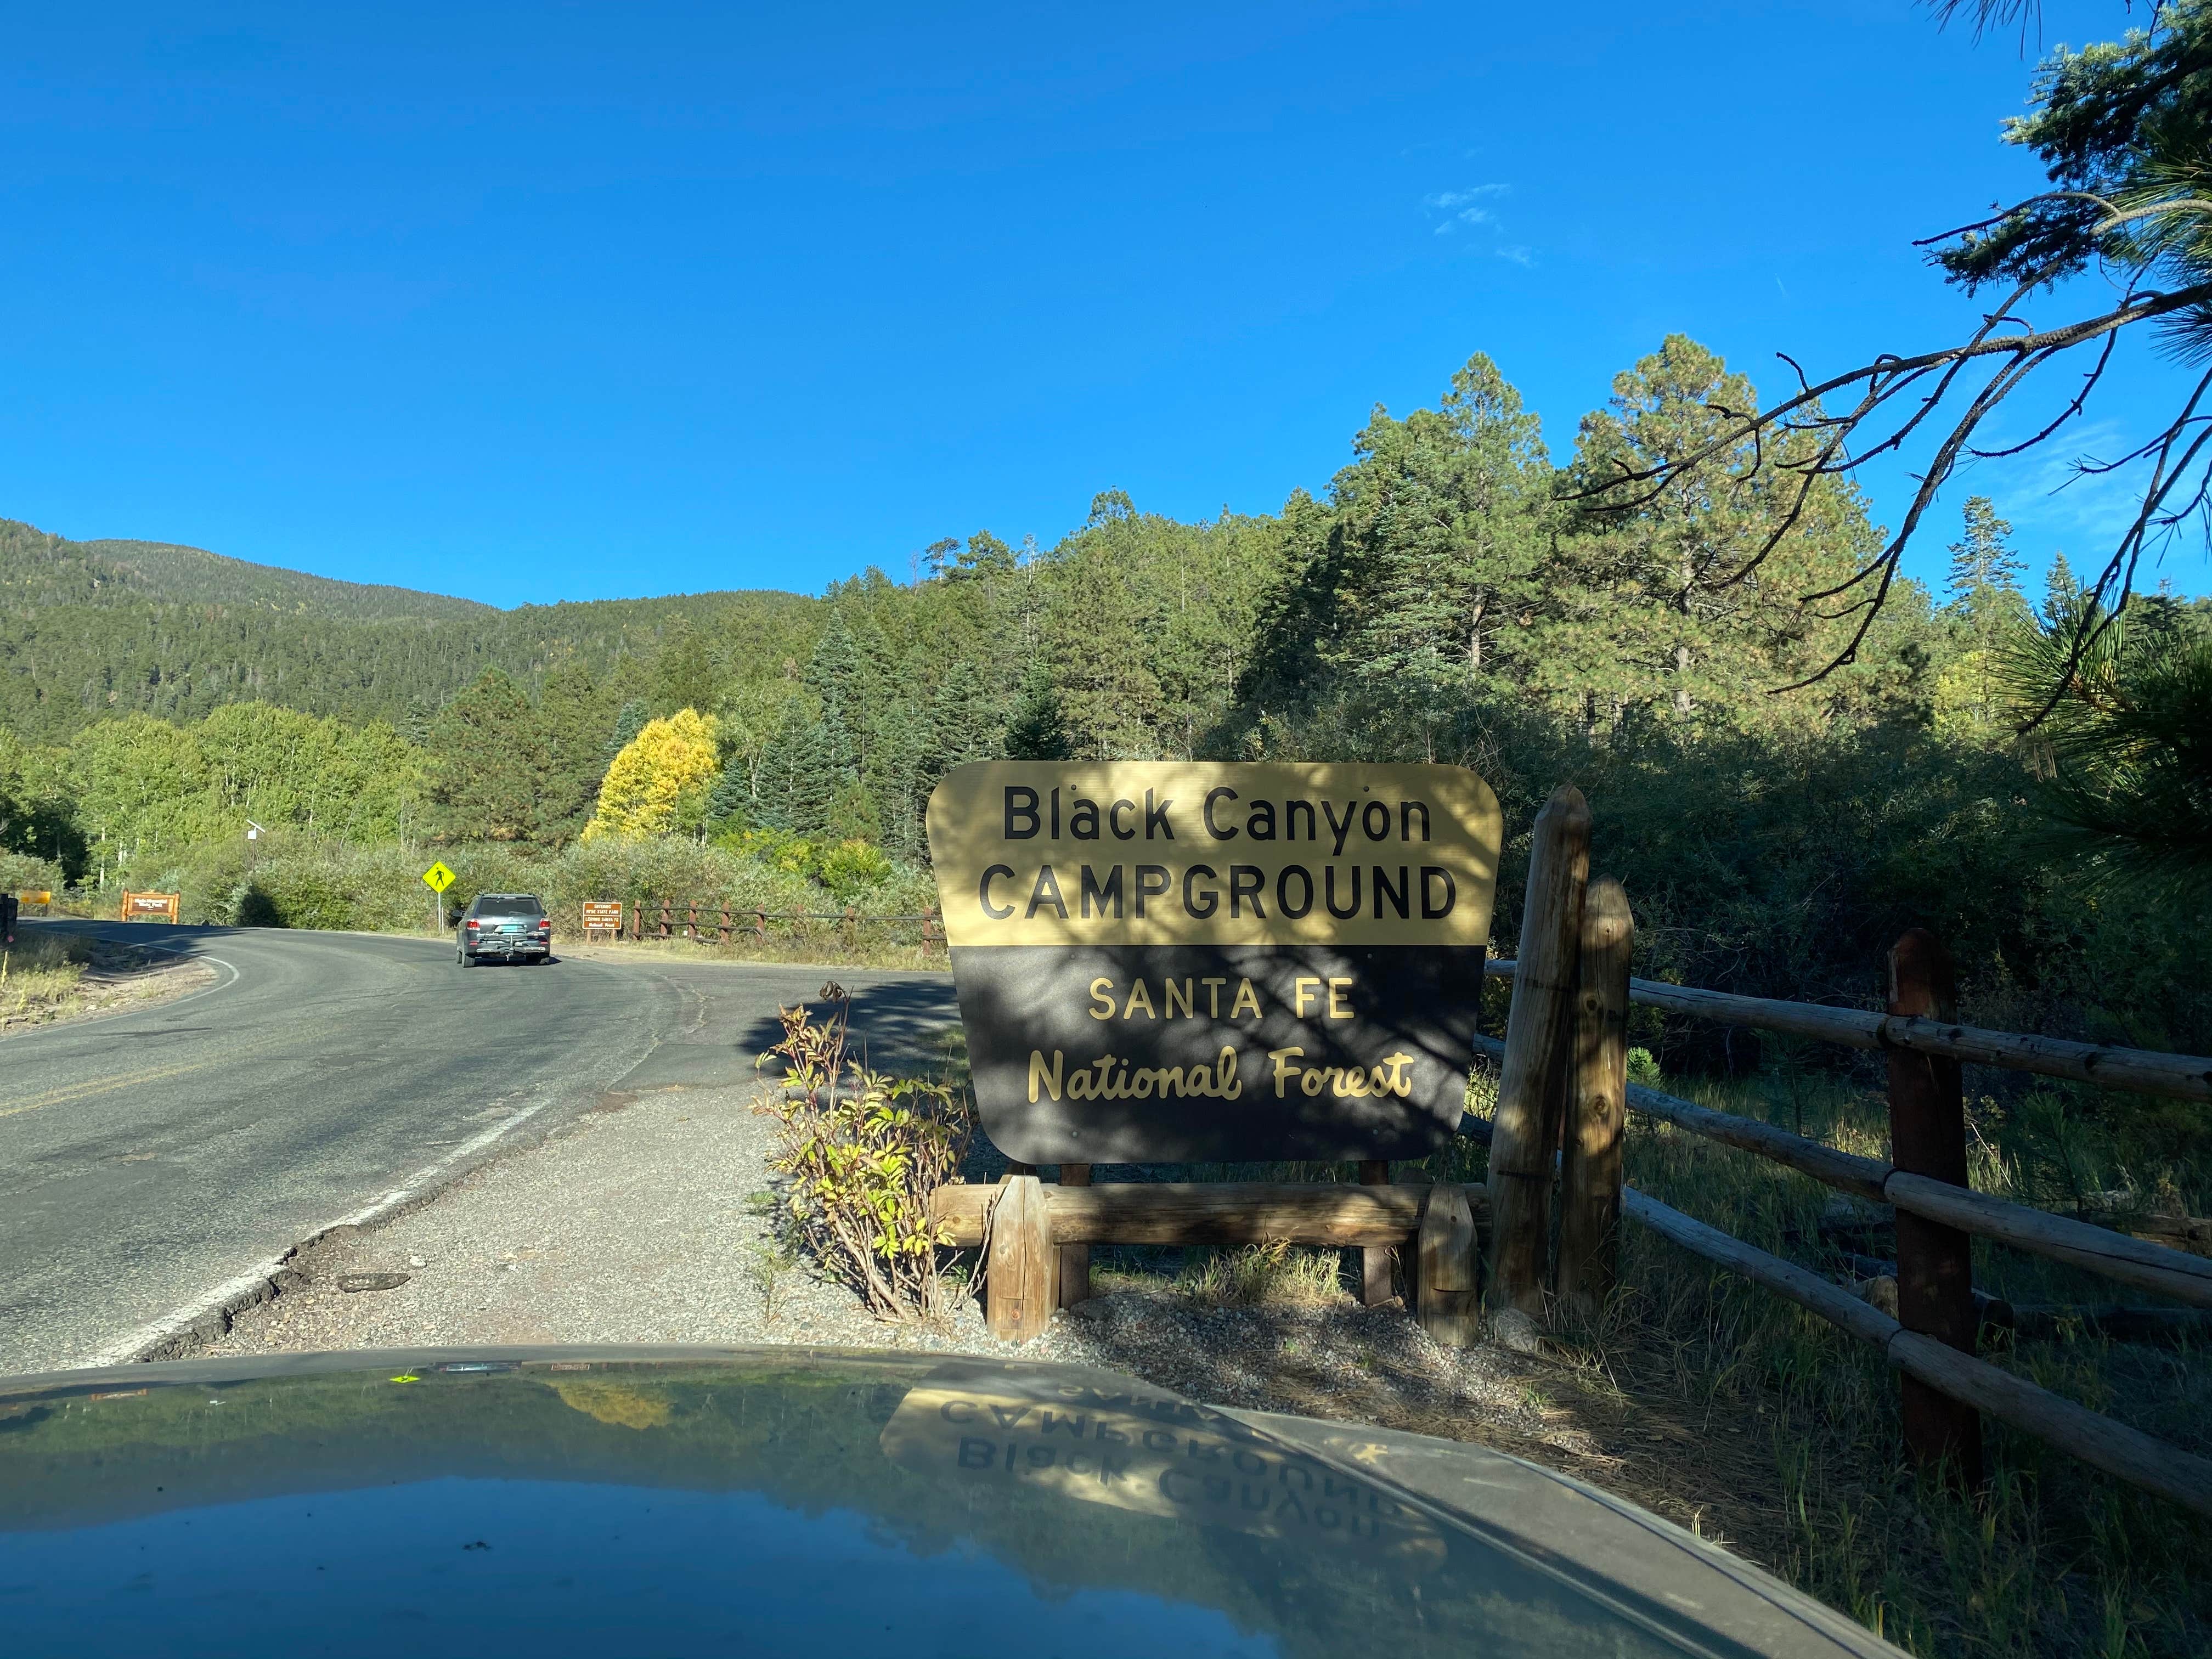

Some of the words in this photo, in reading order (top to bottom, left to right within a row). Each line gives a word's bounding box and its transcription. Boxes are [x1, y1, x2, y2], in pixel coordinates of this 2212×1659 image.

[1003, 785, 1175, 841] Black
[1203, 786, 1431, 856] Canyon
[979, 864, 1457, 920] CAMPGROUND
[1088, 977, 1263, 1020] SANTA
[1295, 977, 1356, 1019] FE
[1028, 1045, 1242, 1103] National
[1267, 1046, 1414, 1098] Forest
